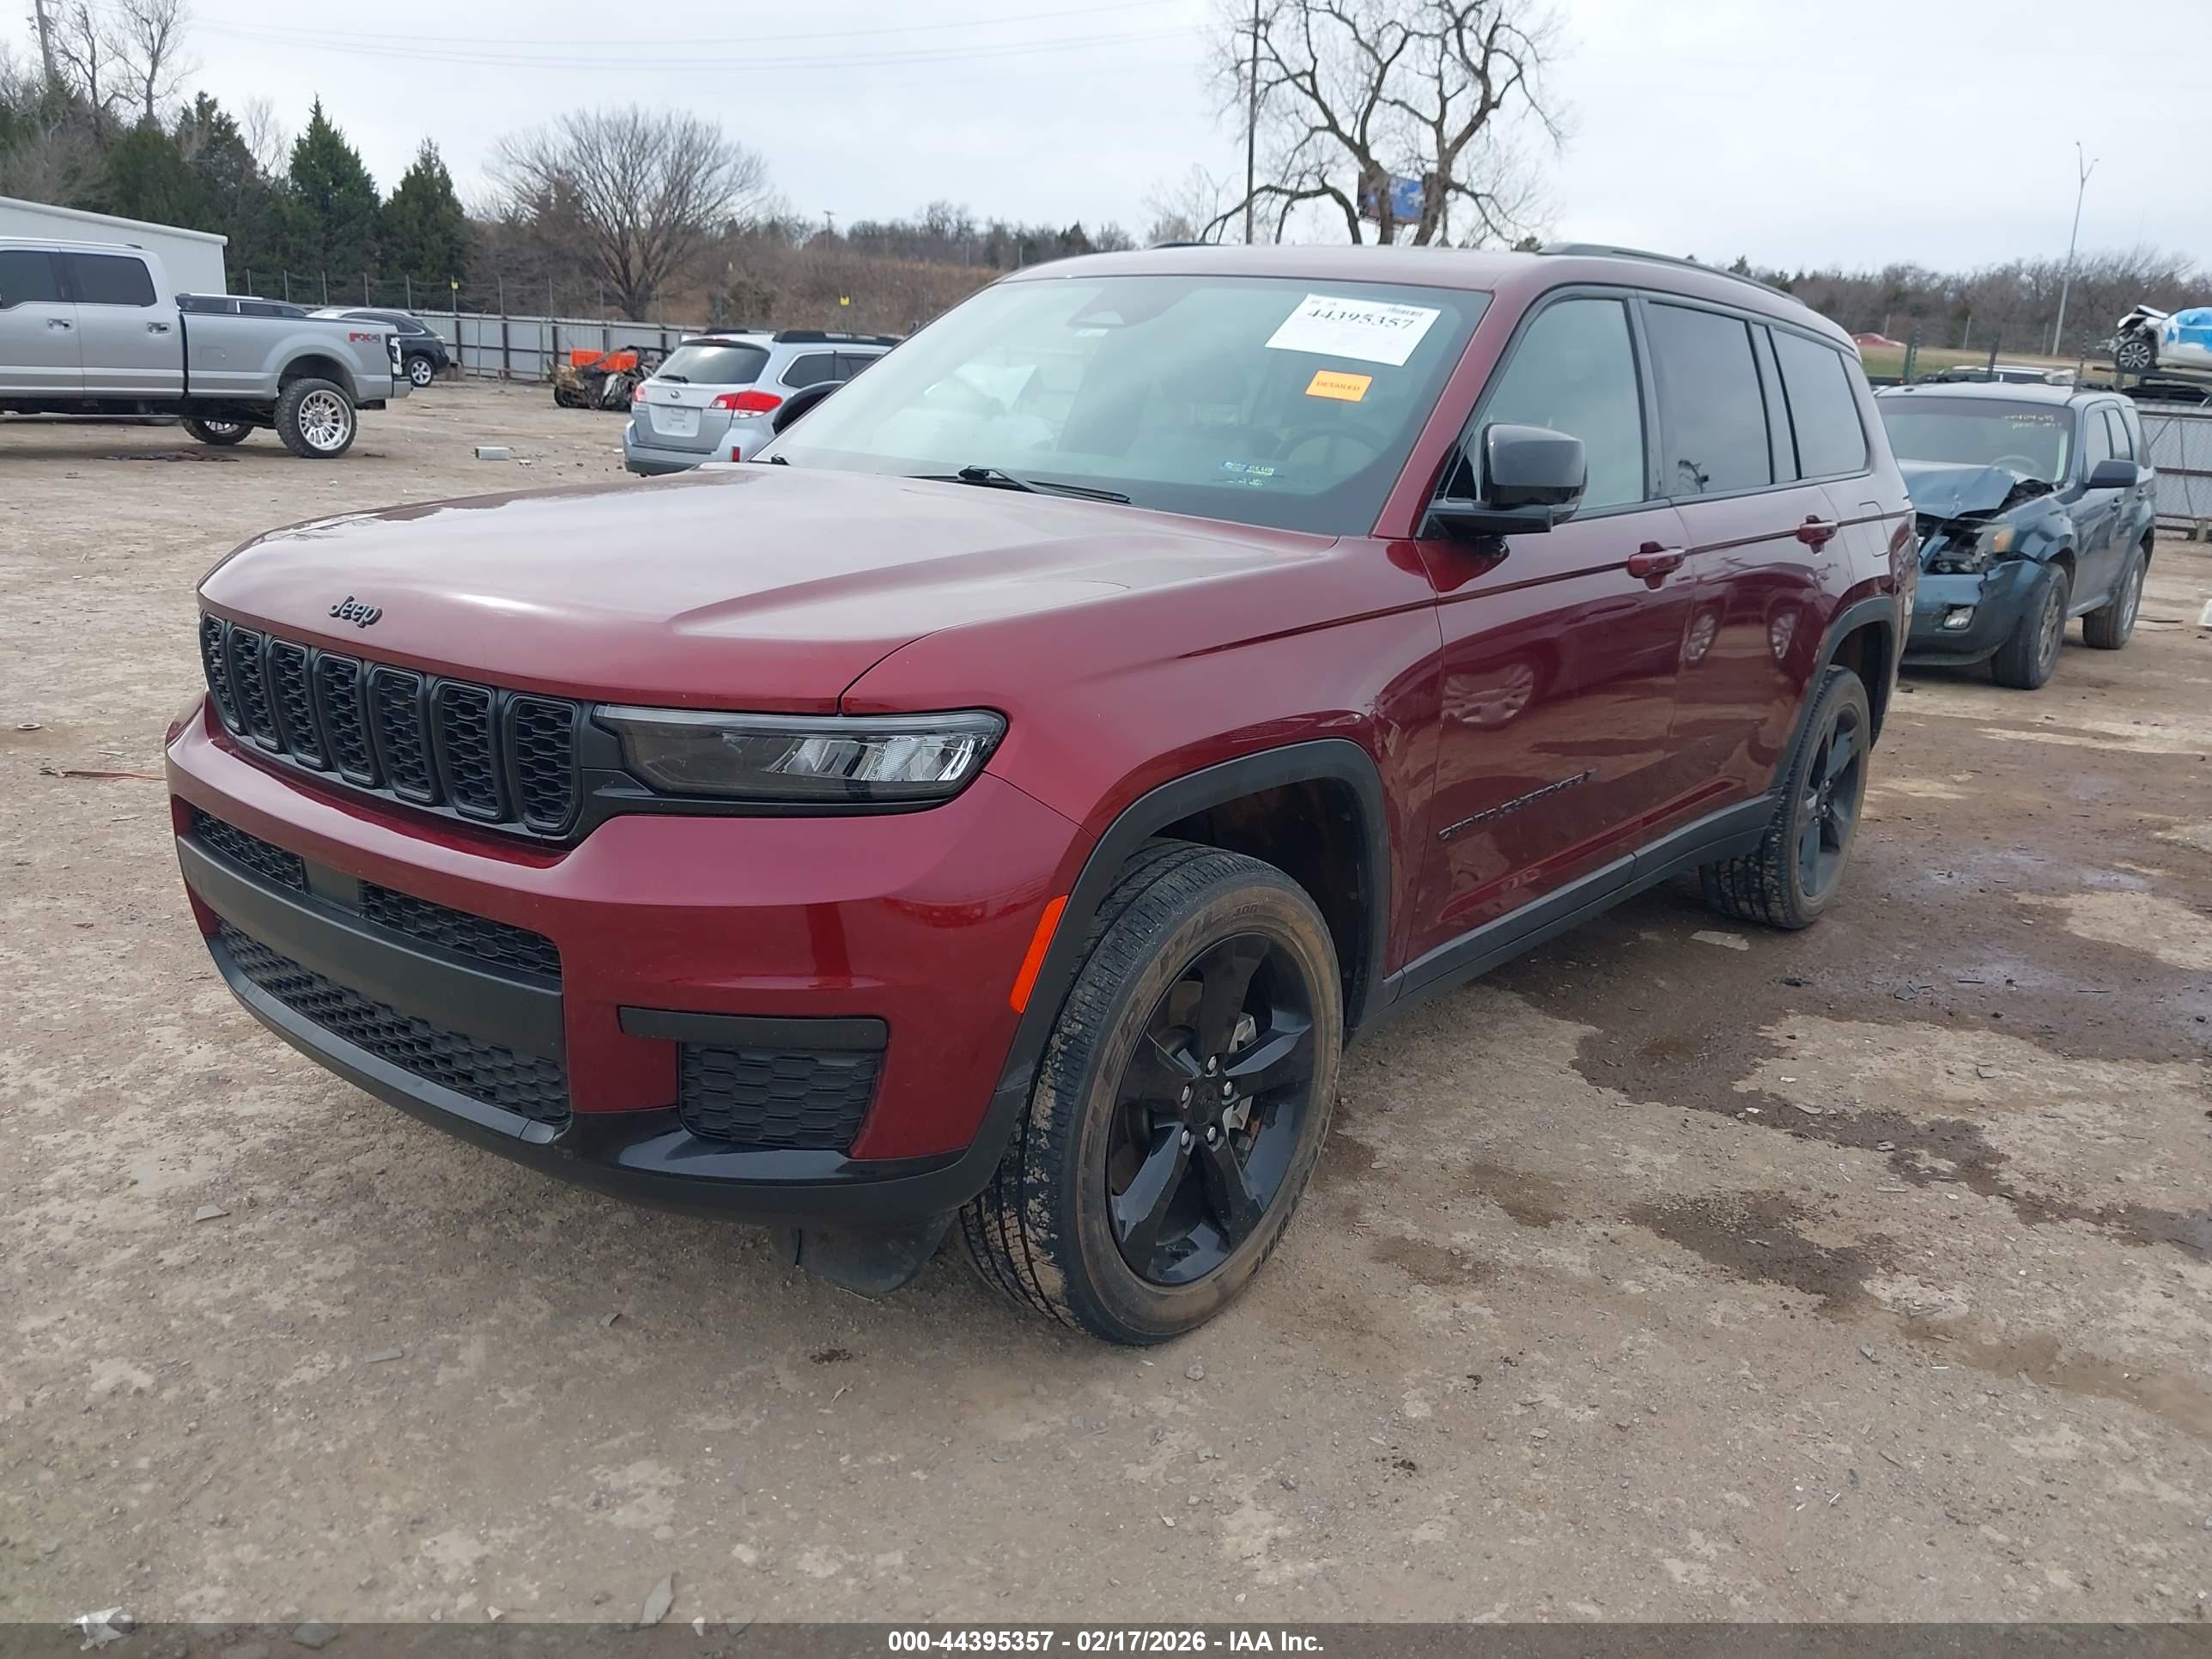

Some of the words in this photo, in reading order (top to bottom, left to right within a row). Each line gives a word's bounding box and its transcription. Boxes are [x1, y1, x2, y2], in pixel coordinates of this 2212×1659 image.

[1308, 308, 1415, 330] 44395357
[349, 332, 381, 343] FX4
[329, 596, 383, 629] Jeep
